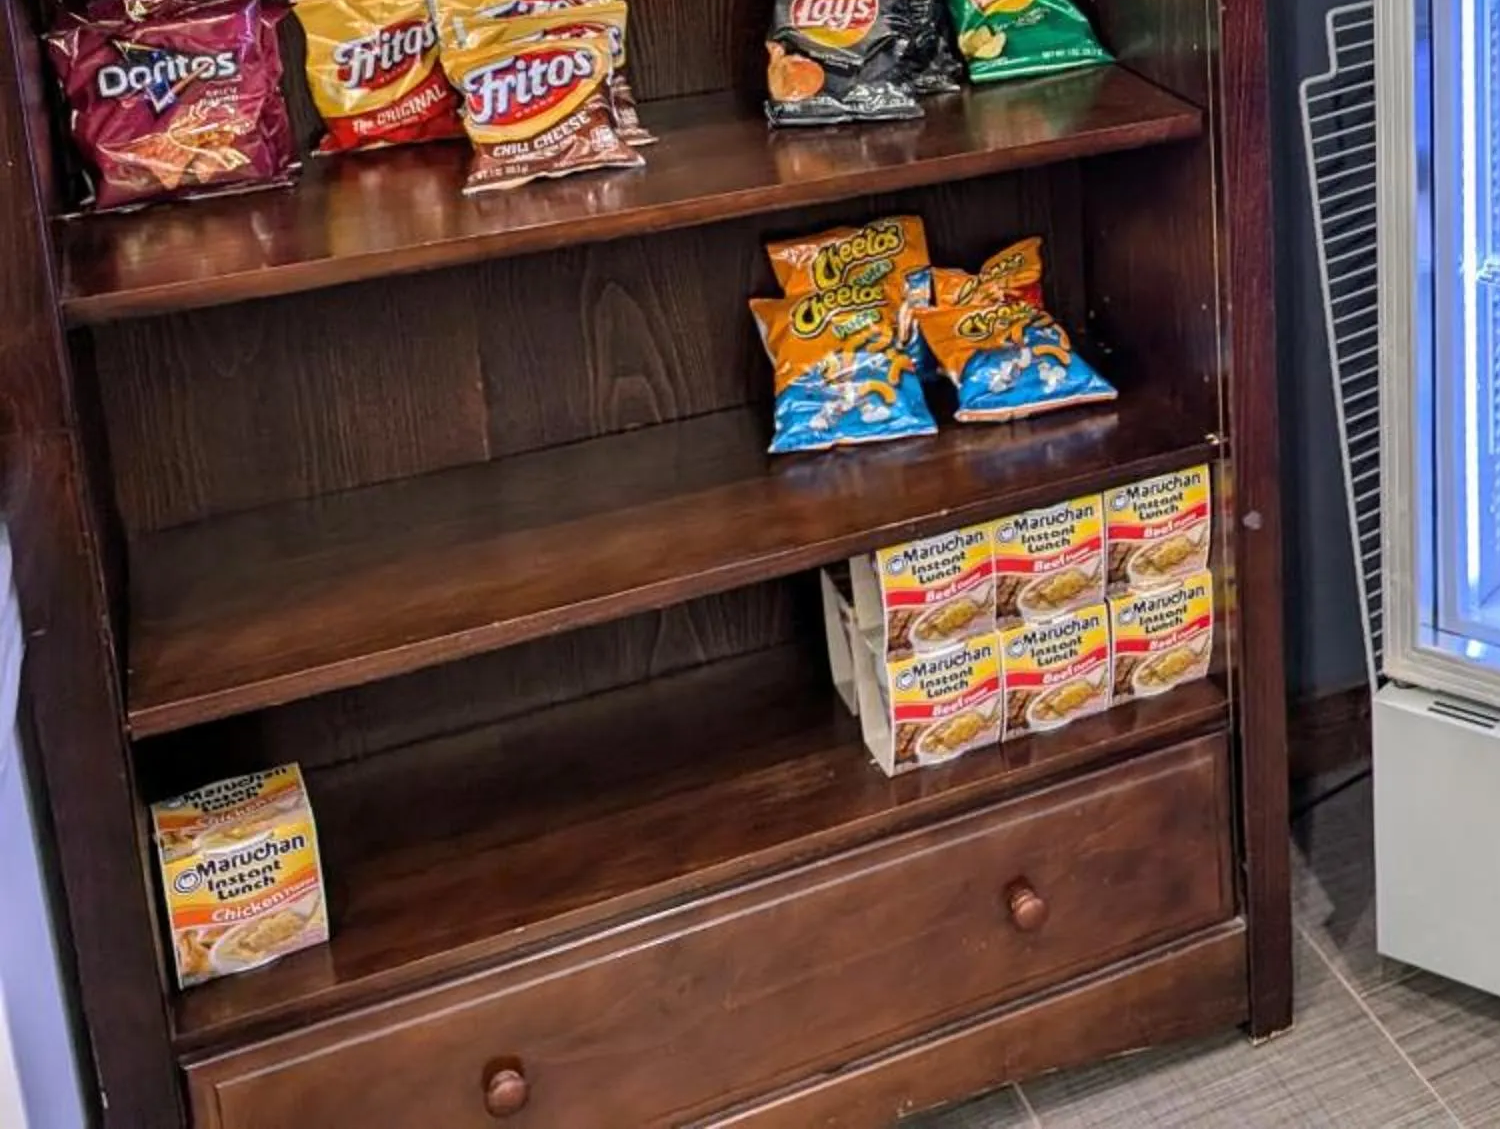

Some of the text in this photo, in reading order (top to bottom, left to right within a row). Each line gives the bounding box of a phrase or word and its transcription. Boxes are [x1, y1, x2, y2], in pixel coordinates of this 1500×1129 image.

[335, 20, 437, 89] Fritos
[98, 52, 236, 98] Doritos
[464, 49, 594, 122] Fritos
[376, 84, 447, 126] ORIGINAL
[492, 142, 530, 158] CHILI
[533, 110, 591, 149] CHEESE
[814, 226, 899, 289] Cheetos
[1126, 472, 1201, 500] Maruchan
[1133, 492, 1184, 512] Instant
[1138, 503, 1180, 520] Lunch
[1013, 504, 1094, 532] Maruchan
[903, 530, 984, 564] Maruchan
[1021, 524, 1075, 545] Instant
[1027, 536, 1071, 554] Lunch
[911, 550, 967, 576] Instant
[919, 565, 962, 585] Lunch
[1133, 584, 1205, 614] Maruchan
[1139, 605, 1187, 625] Instant
[1144, 617, 1183, 634] Lunch
[1022, 615, 1099, 645] Maruchan
[1030, 635, 1082, 658] Instant
[1036, 648, 1078, 667] Lunch
[912, 645, 991, 677] Maruchan
[919, 666, 973, 690] Instant
[927, 680, 969, 700] Lunch
[196, 834, 305, 877] Maruchan
[207, 861, 282, 892] Instant
[217, 875, 276, 901] Lunch
[212, 890, 284, 922] Chicken
